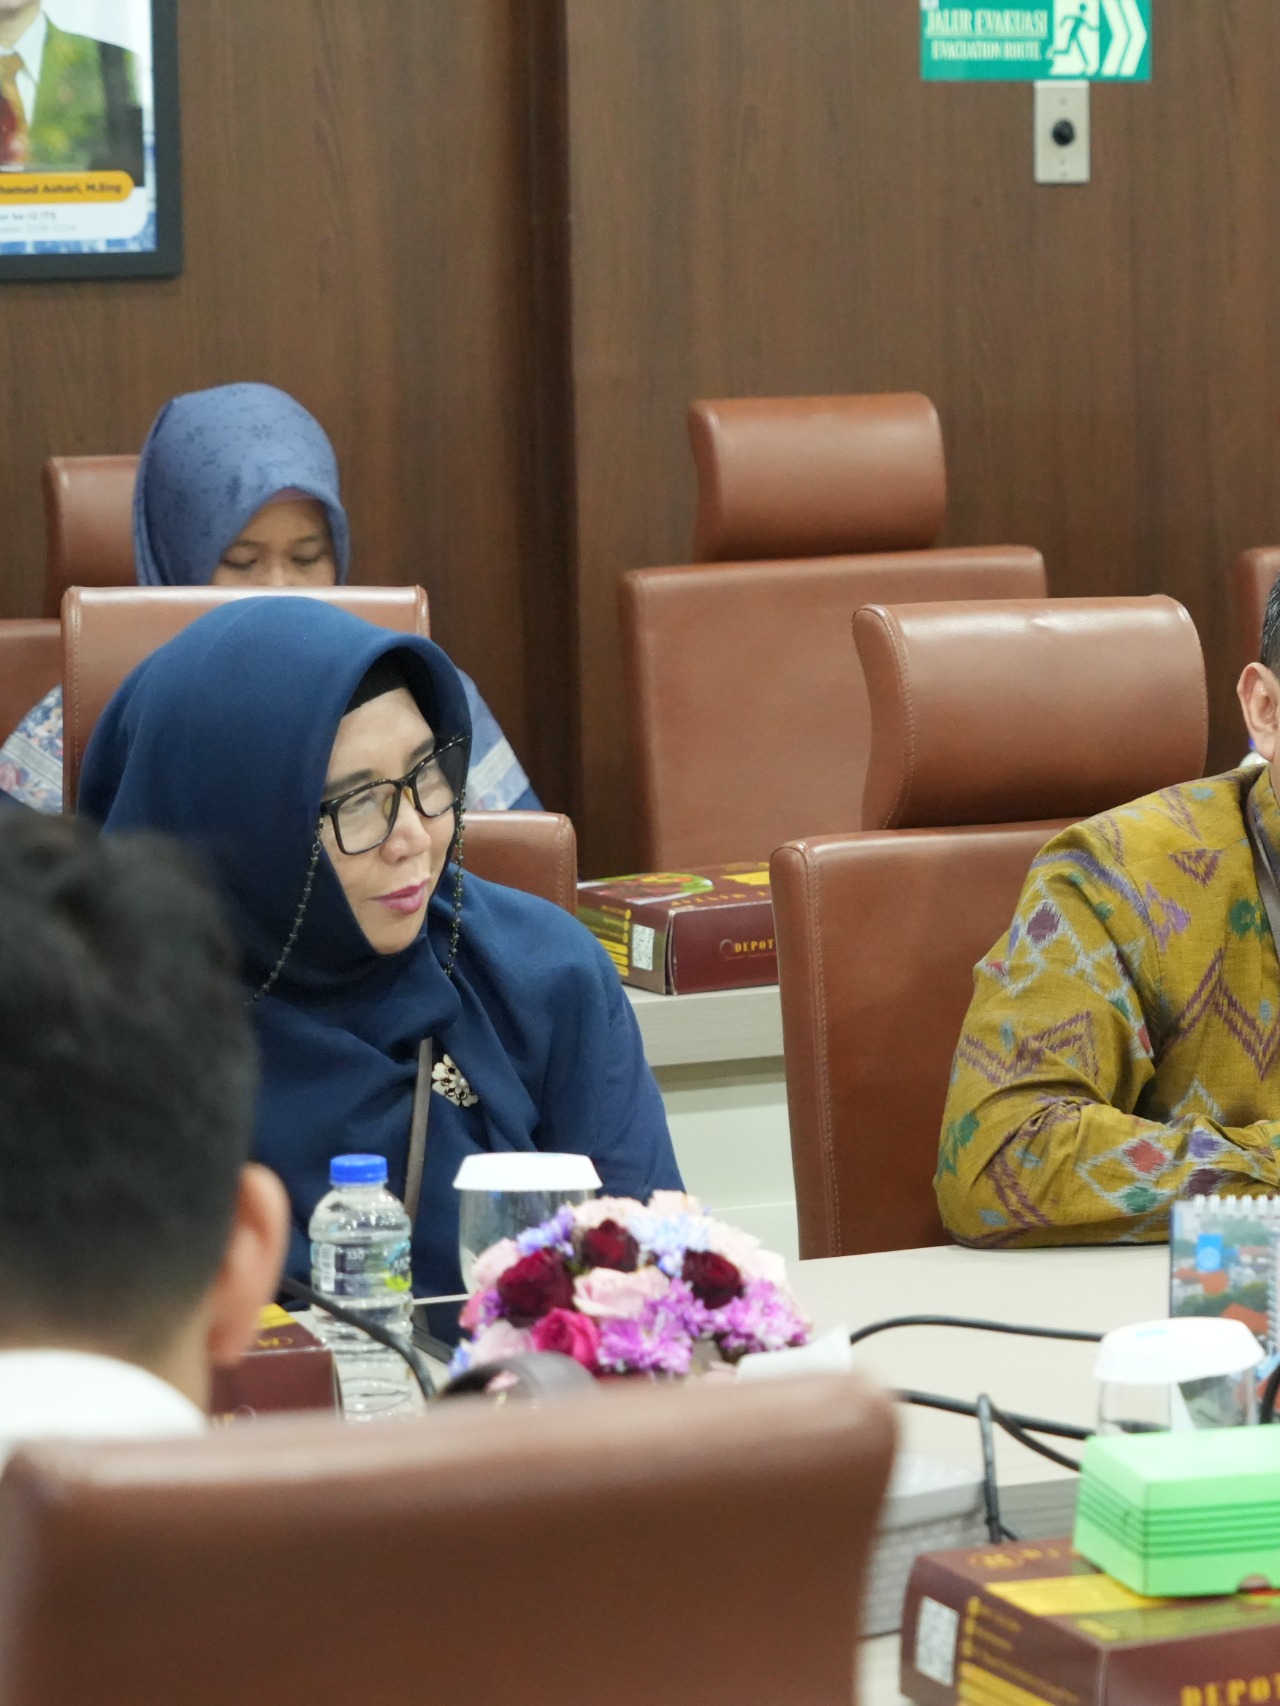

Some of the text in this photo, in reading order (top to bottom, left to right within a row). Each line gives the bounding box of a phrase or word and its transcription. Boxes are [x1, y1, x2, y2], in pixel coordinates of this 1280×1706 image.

[926, 9, 1048, 36] JALUR EVAKUASI
[931, 40, 1042, 61] EVACUATION ROUTE
[734, 938, 775, 954] DEPOT
